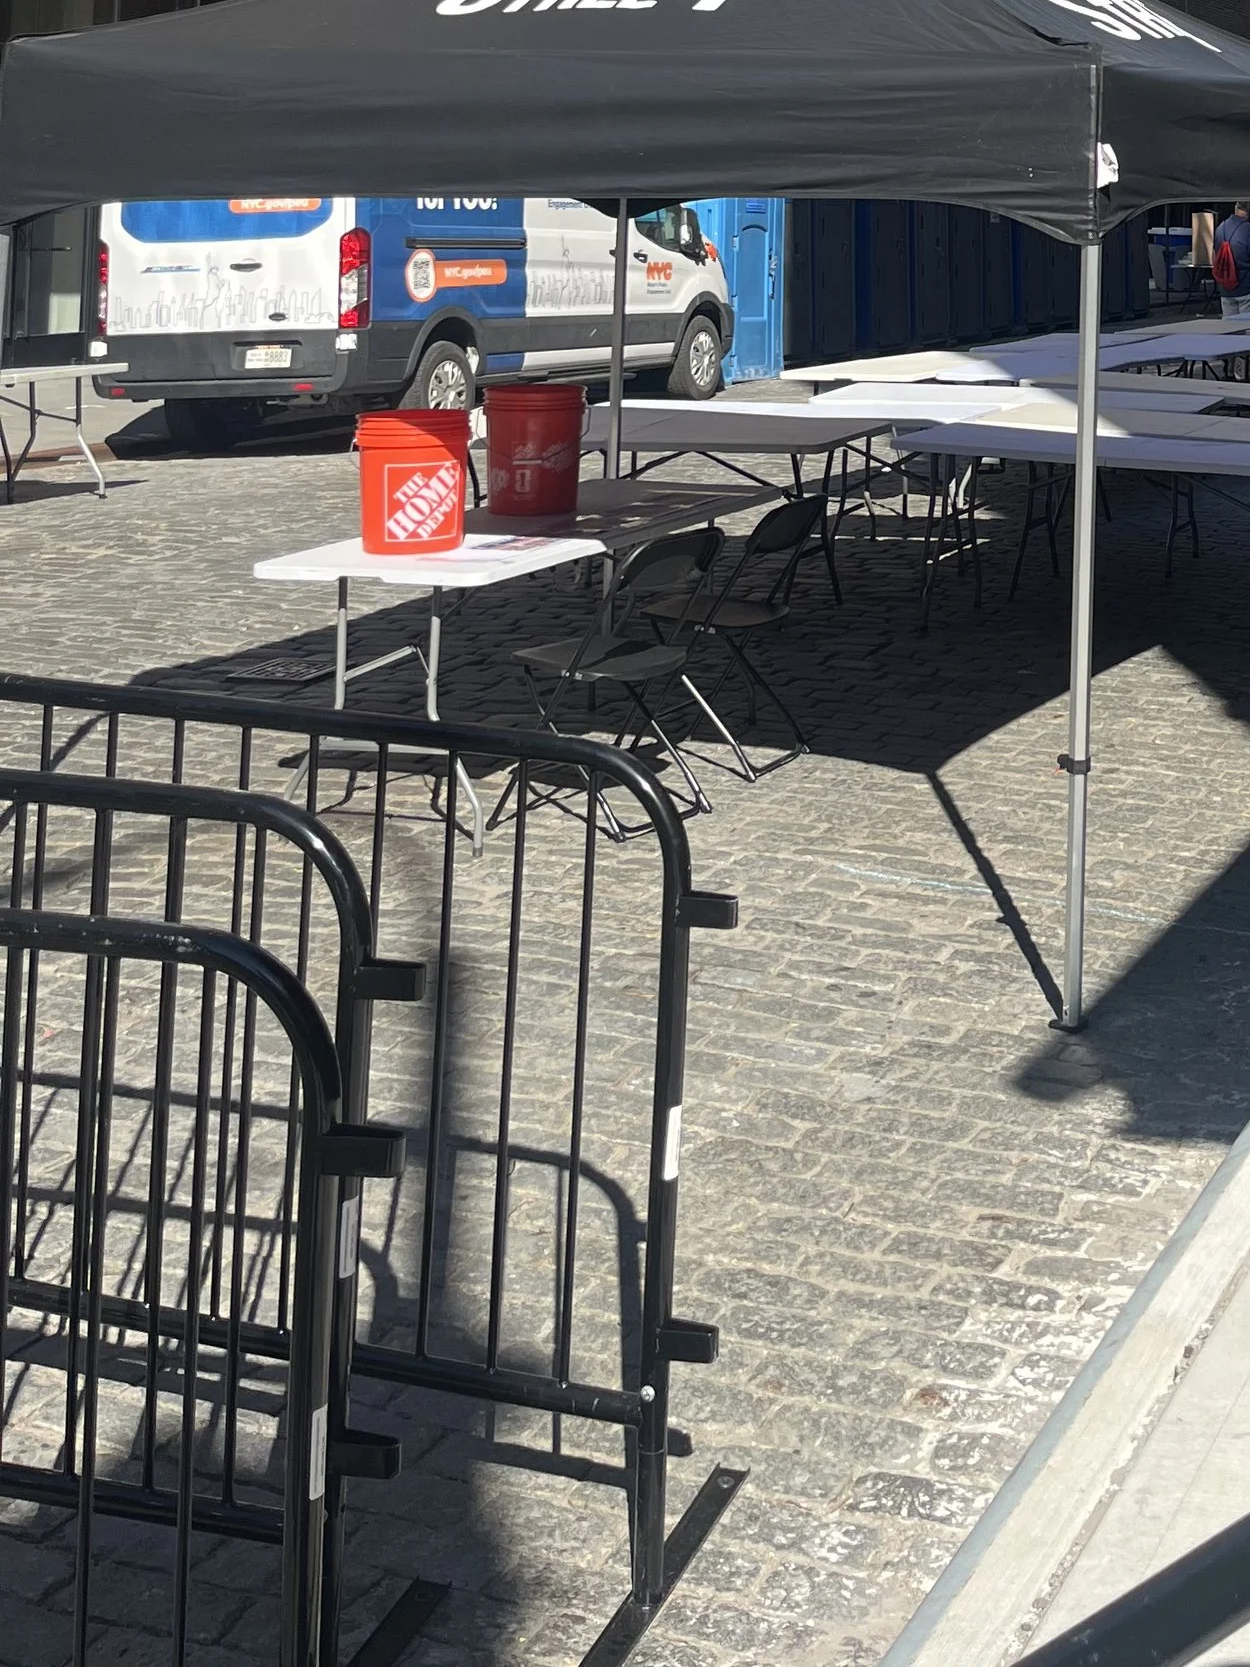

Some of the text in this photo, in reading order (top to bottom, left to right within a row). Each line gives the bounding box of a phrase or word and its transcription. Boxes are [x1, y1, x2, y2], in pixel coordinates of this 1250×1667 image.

[647, 262, 673, 281] NYC
[386, 460, 460, 540] HOME
[392, 471, 430, 505] THE
[415, 488, 459, 539] DEPOT
